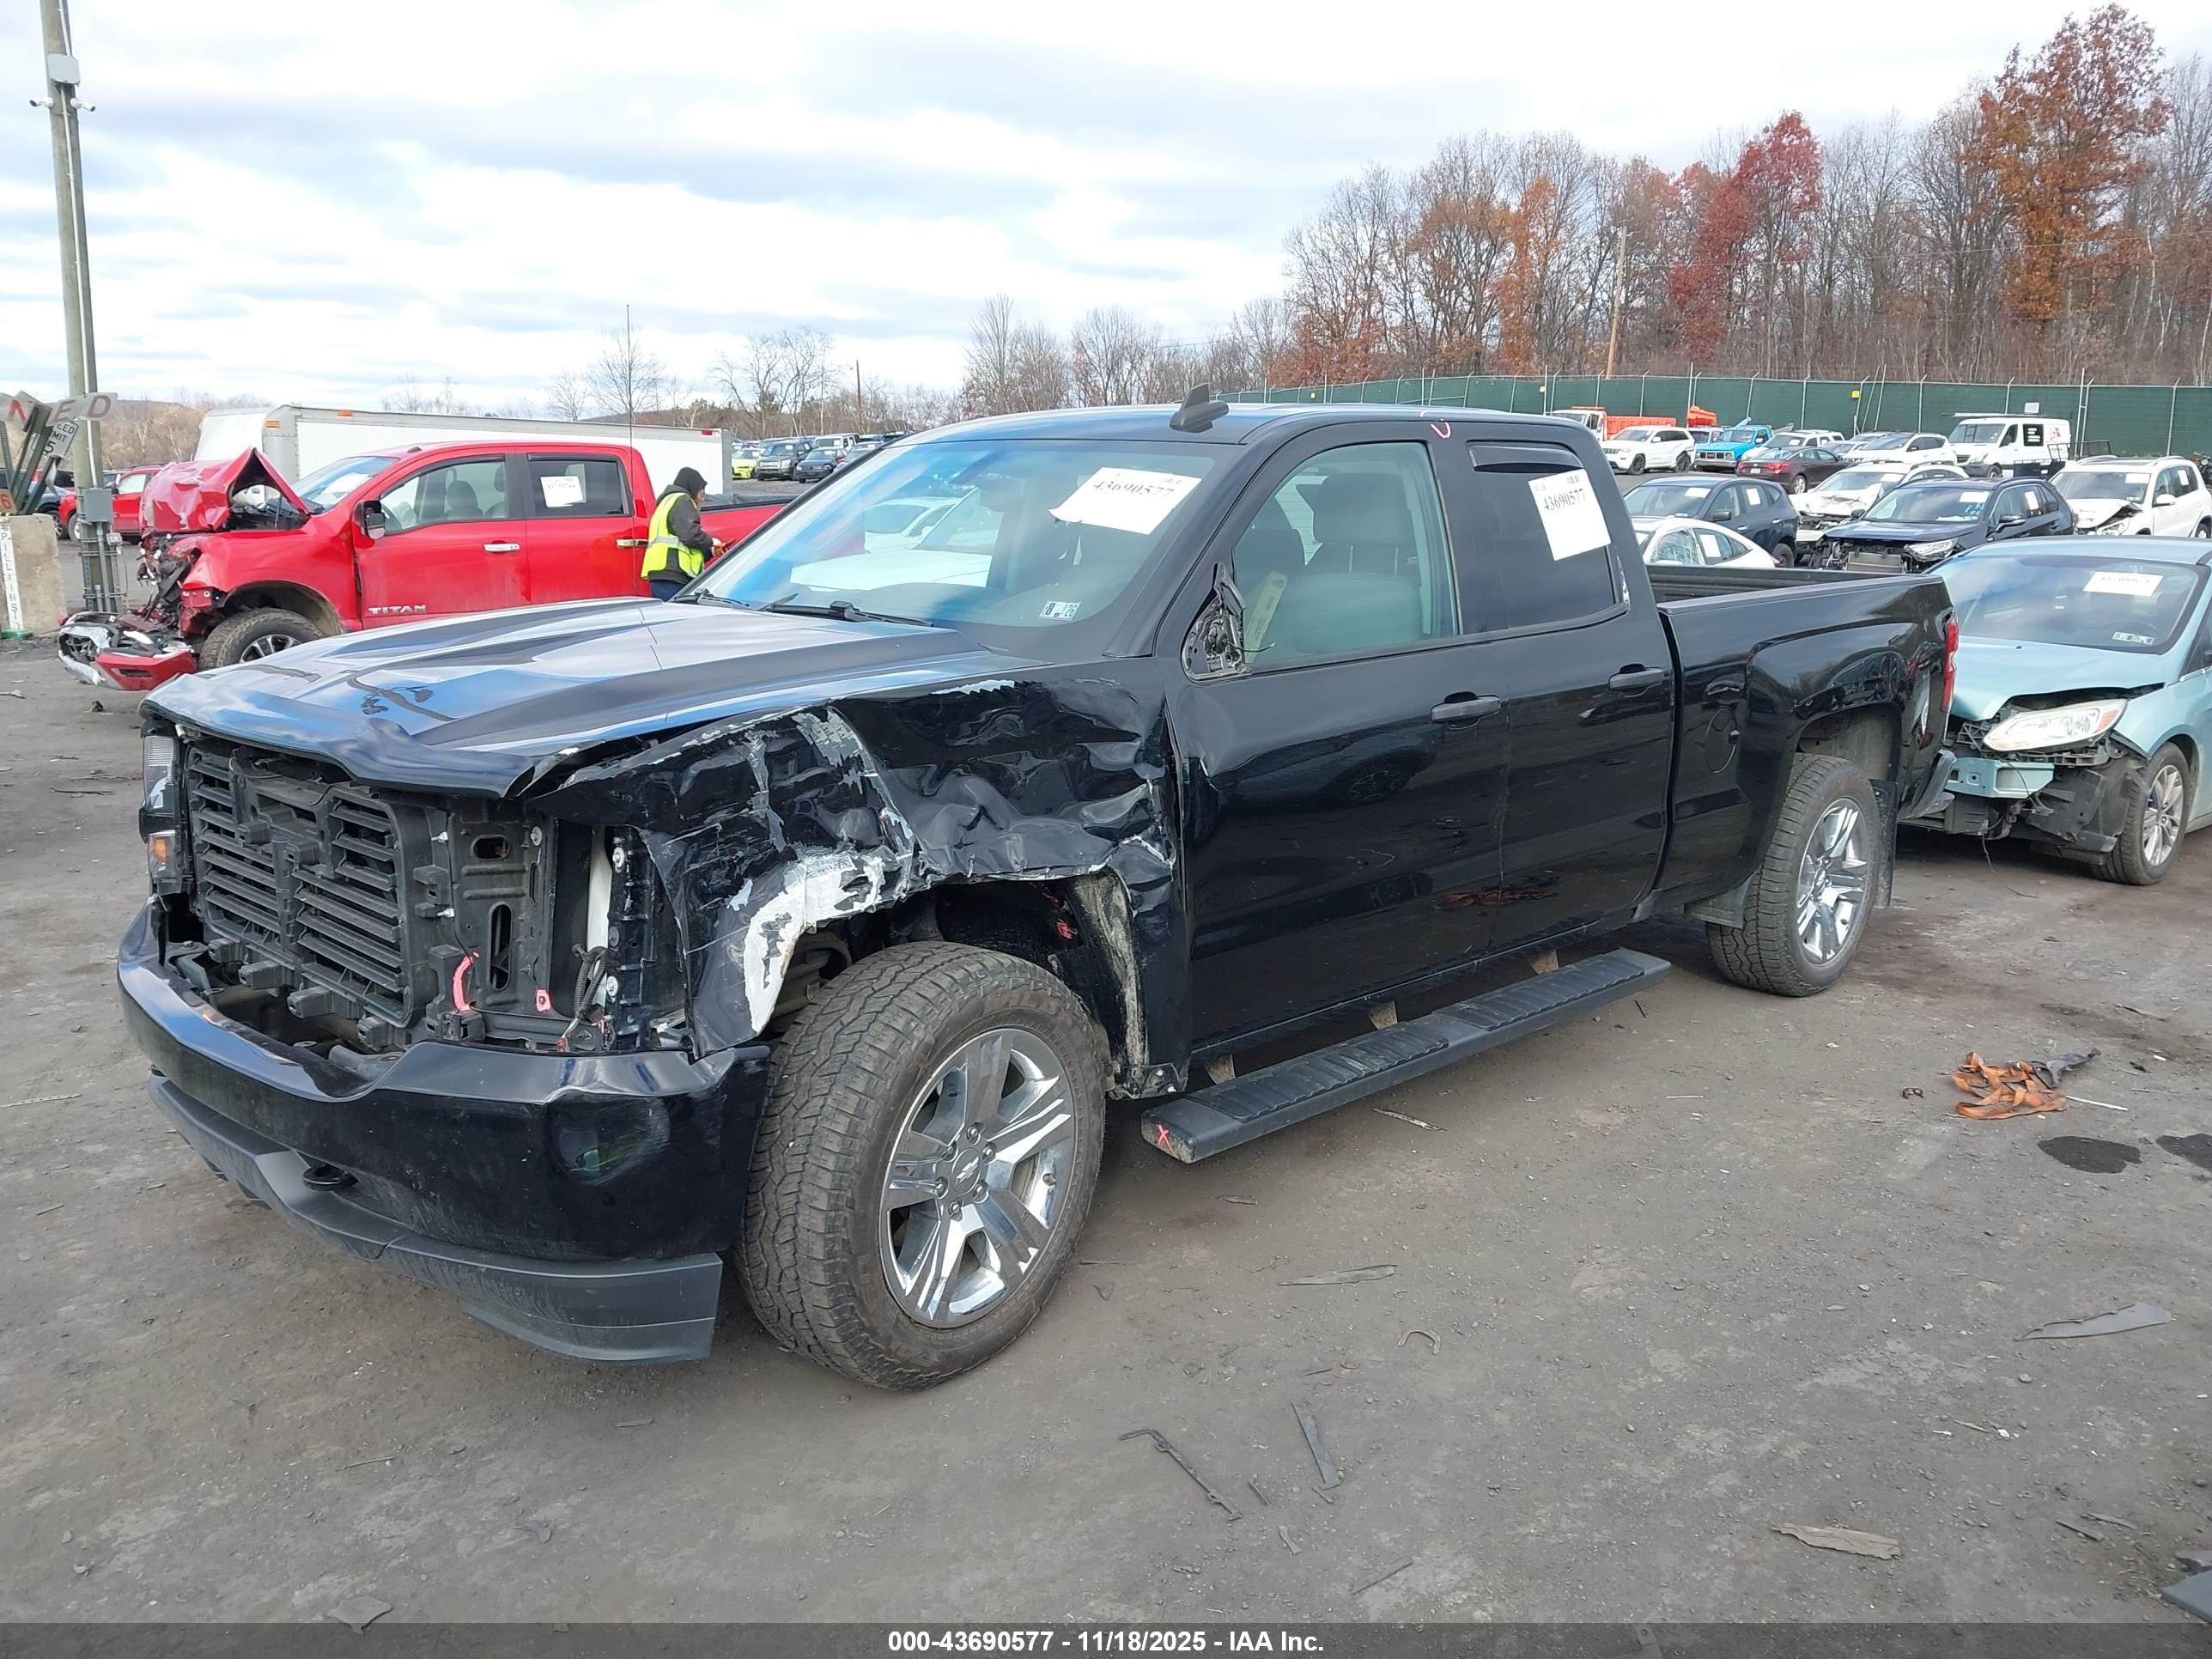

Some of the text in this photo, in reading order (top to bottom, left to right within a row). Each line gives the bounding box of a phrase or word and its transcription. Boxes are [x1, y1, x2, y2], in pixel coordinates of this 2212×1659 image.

[57, 423, 76, 434] EED
[52, 431, 68, 443] MIT
[1093, 480, 1176, 496] 43690577
[1544, 488, 1587, 511] 43690577
[368, 605, 426, 615] TITAN
